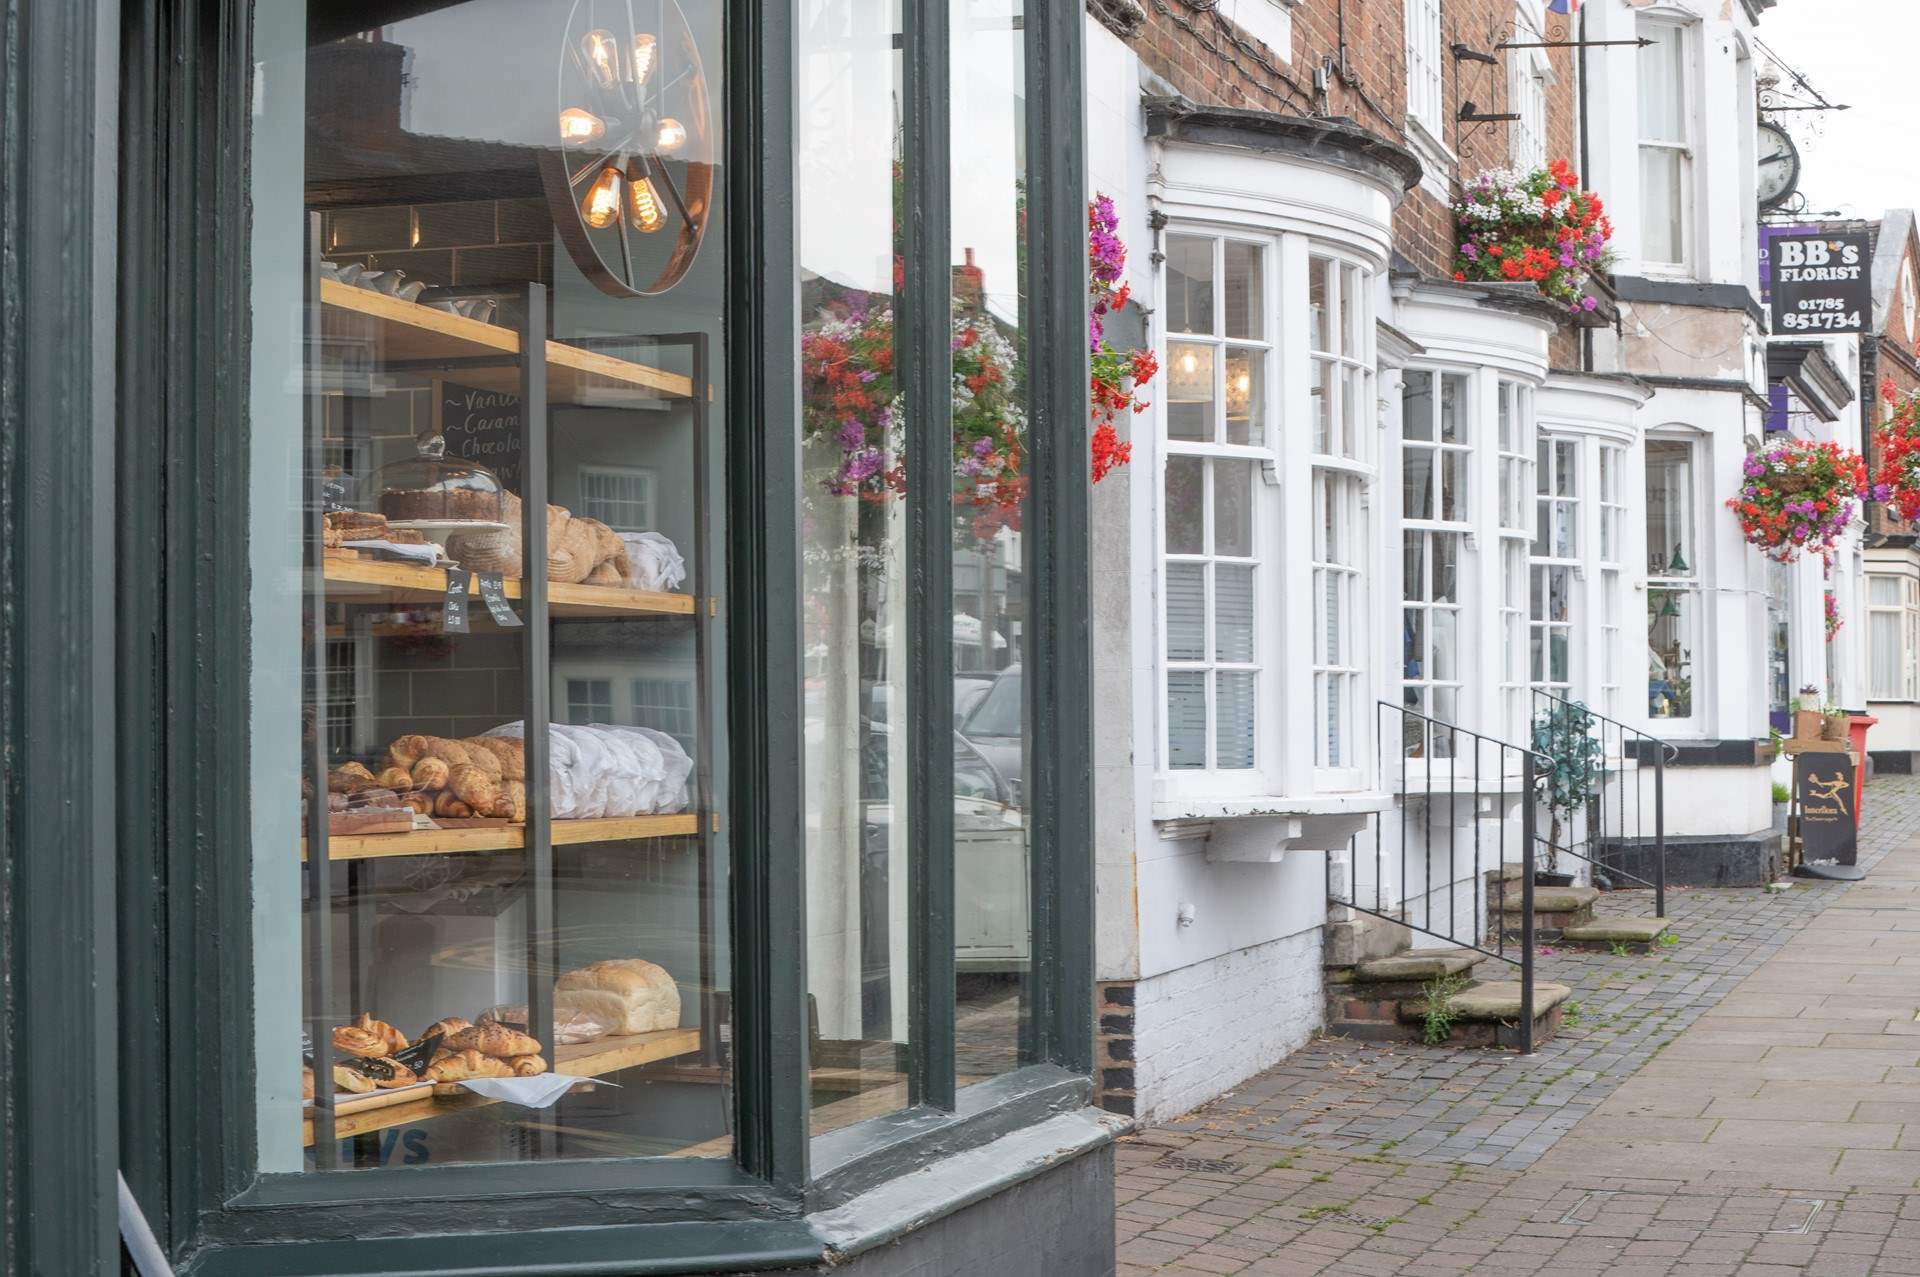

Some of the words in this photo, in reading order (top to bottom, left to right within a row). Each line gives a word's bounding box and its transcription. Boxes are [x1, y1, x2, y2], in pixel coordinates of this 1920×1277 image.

[1776, 145, 1784, 154] 2
[1780, 266, 1861, 282] FLORIST
[1798, 298, 1845, 310] 01785
[1783, 311, 1861, 329] 851734
